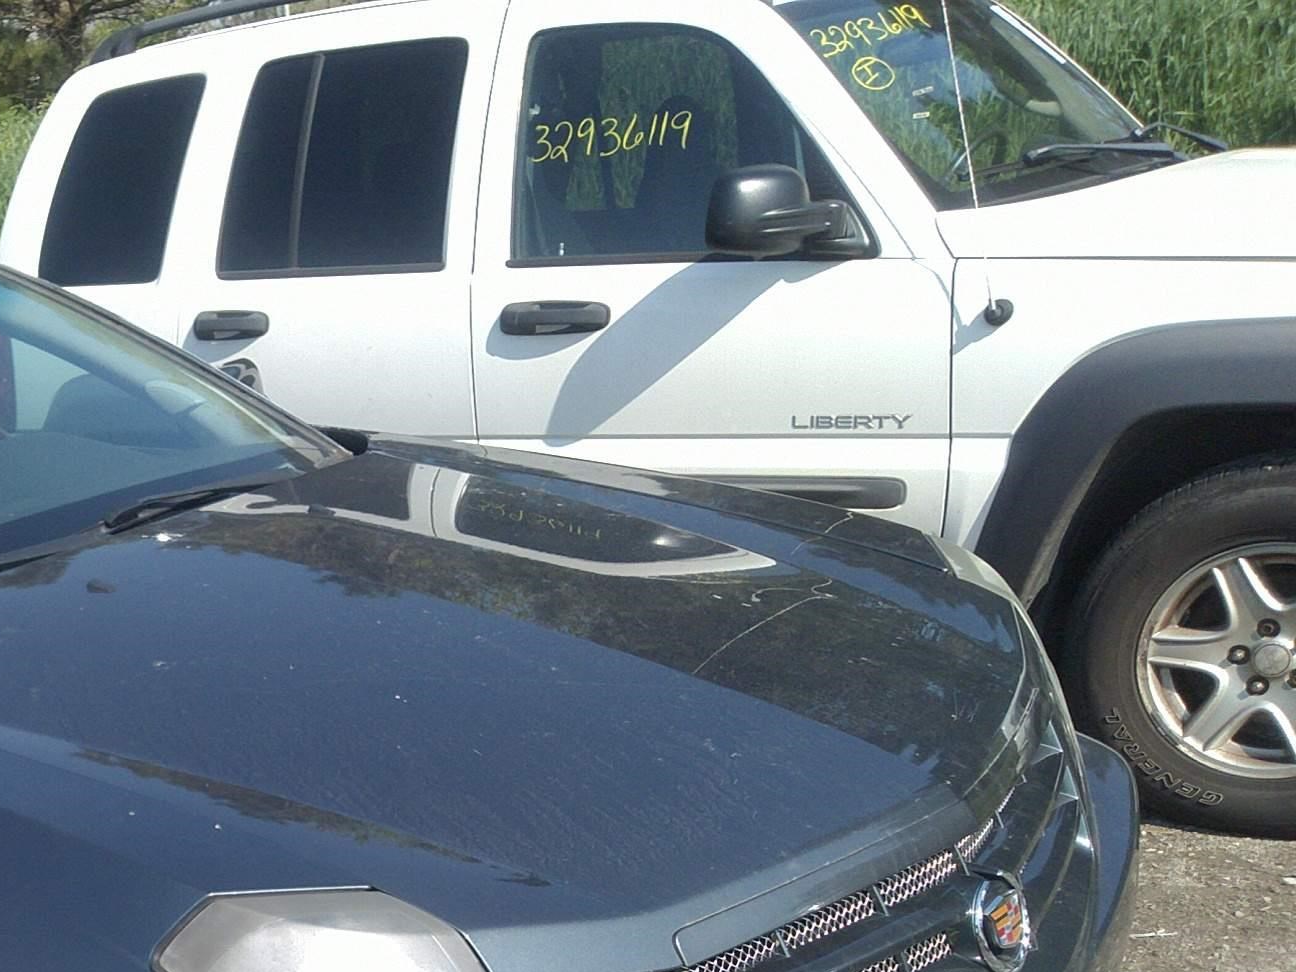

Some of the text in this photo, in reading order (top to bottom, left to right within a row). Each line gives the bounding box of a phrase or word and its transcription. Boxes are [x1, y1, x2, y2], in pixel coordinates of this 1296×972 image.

[809, 4, 932, 58] 32936119
[530, 110, 692, 163] 32936119
[791, 414, 913, 430] LIBERTY
[1104, 707, 1224, 806] GENERAL
